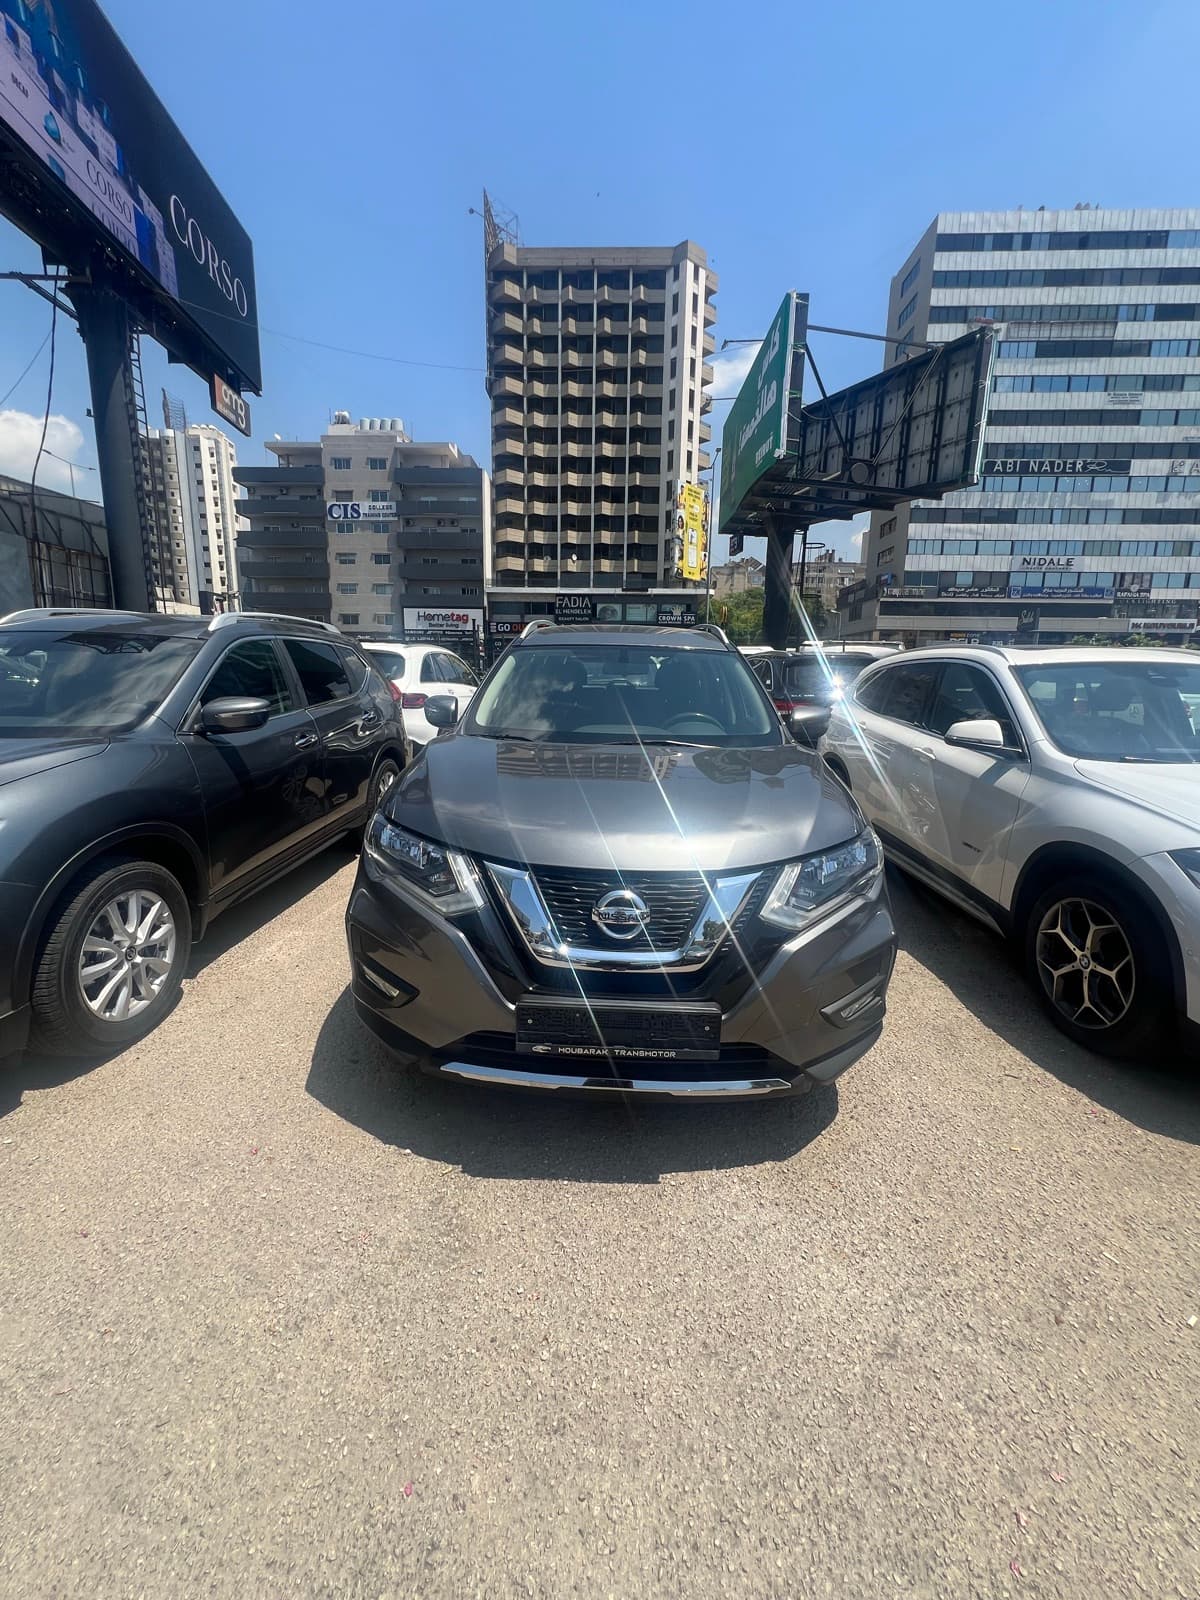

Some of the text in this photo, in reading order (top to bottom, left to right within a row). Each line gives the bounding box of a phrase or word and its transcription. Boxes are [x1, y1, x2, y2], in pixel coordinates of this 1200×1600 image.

[86, 159, 132, 223] CORSO
[170, 195, 248, 317] CORSO
[993, 460, 1084, 473] ABI NADER
[328, 503, 361, 520] CIS
[1022, 557, 1075, 567] NIDALE
[556, 596, 591, 608] FADIA
[417, 611, 469, 624] Hometag
[498, 623, 510, 632] GO
[558, 1047, 677, 1058] MOUBARAK TRANSMOTOR
